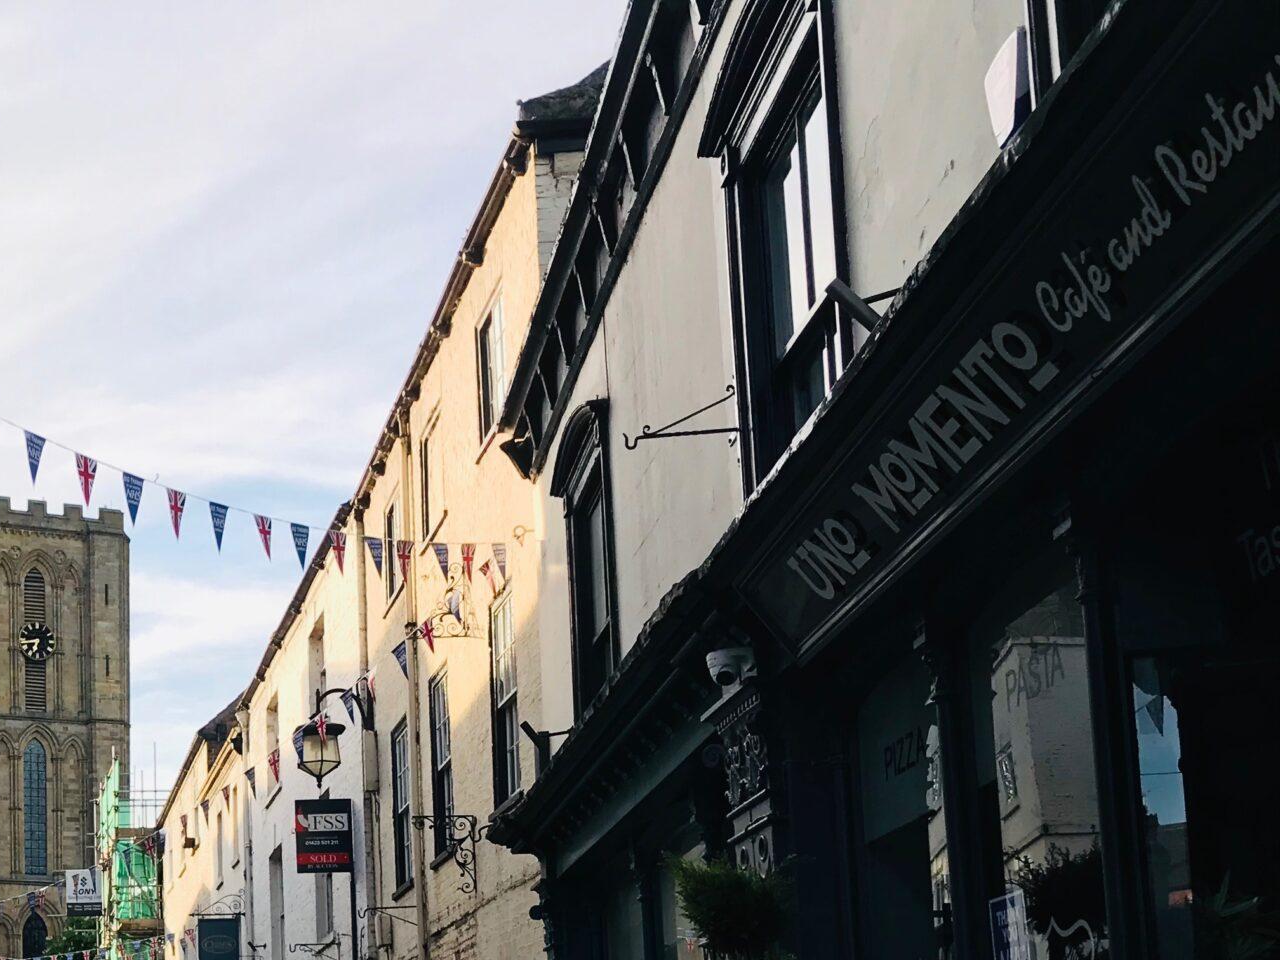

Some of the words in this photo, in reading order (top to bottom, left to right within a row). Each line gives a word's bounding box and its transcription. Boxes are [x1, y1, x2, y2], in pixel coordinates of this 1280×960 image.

[787, 518, 871, 600] UNO
[851, 321, 1060, 534] MOMENTO
[1035, 248, 1111, 332] Café
[1107, 174, 1171, 271] and
[1155, 57, 1280, 206] Restau
[126, 488, 141, 501] NHS
[1005, 641, 1065, 713] PASTA
[884, 726, 928, 782] PIZZA
[312, 814, 345, 830] FSS
[310, 854, 337, 863] SOLD
